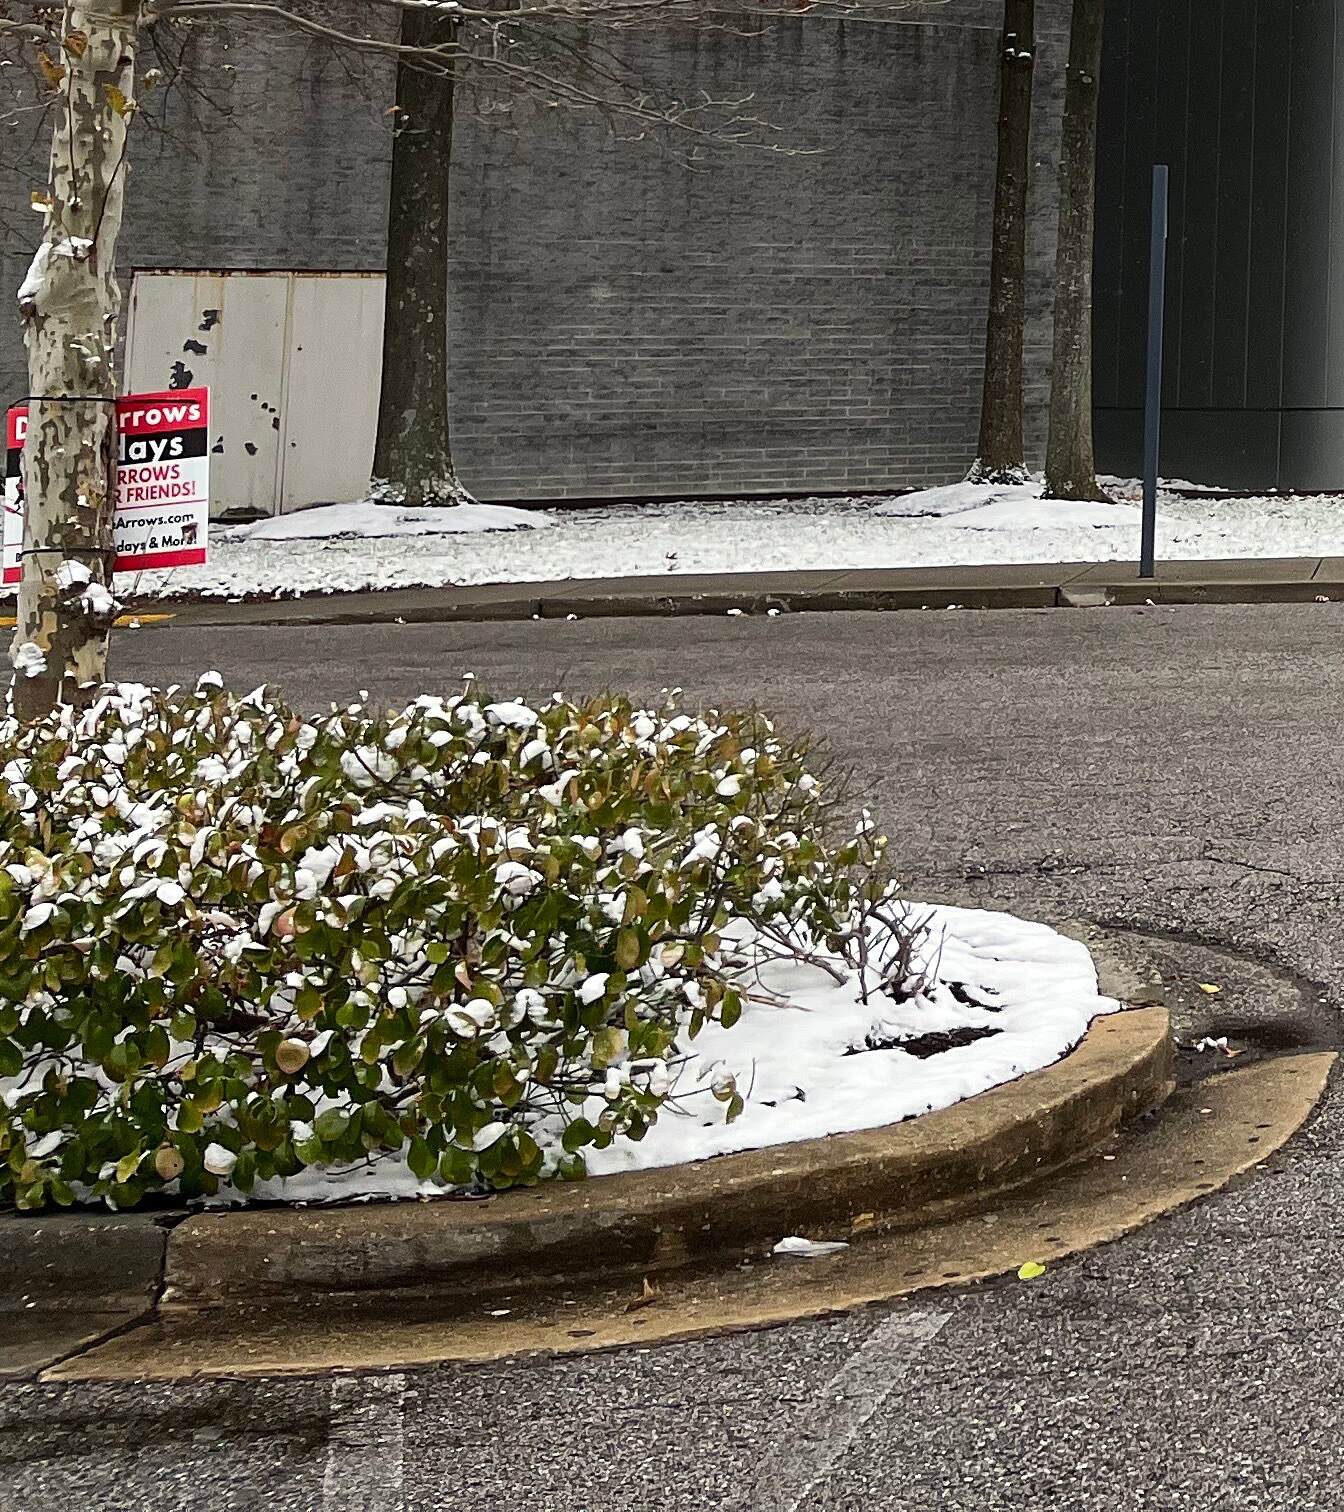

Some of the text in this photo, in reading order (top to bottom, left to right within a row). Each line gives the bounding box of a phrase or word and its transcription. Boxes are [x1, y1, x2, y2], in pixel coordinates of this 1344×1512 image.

[118, 403, 201, 428] rrows
[117, 464, 181, 486] RROWS
[126, 481, 196, 502] FRIENDS!
[114, 513, 194, 529] Arrows.com
[117, 539, 146, 555] days
[149, 536, 159, 548] &
